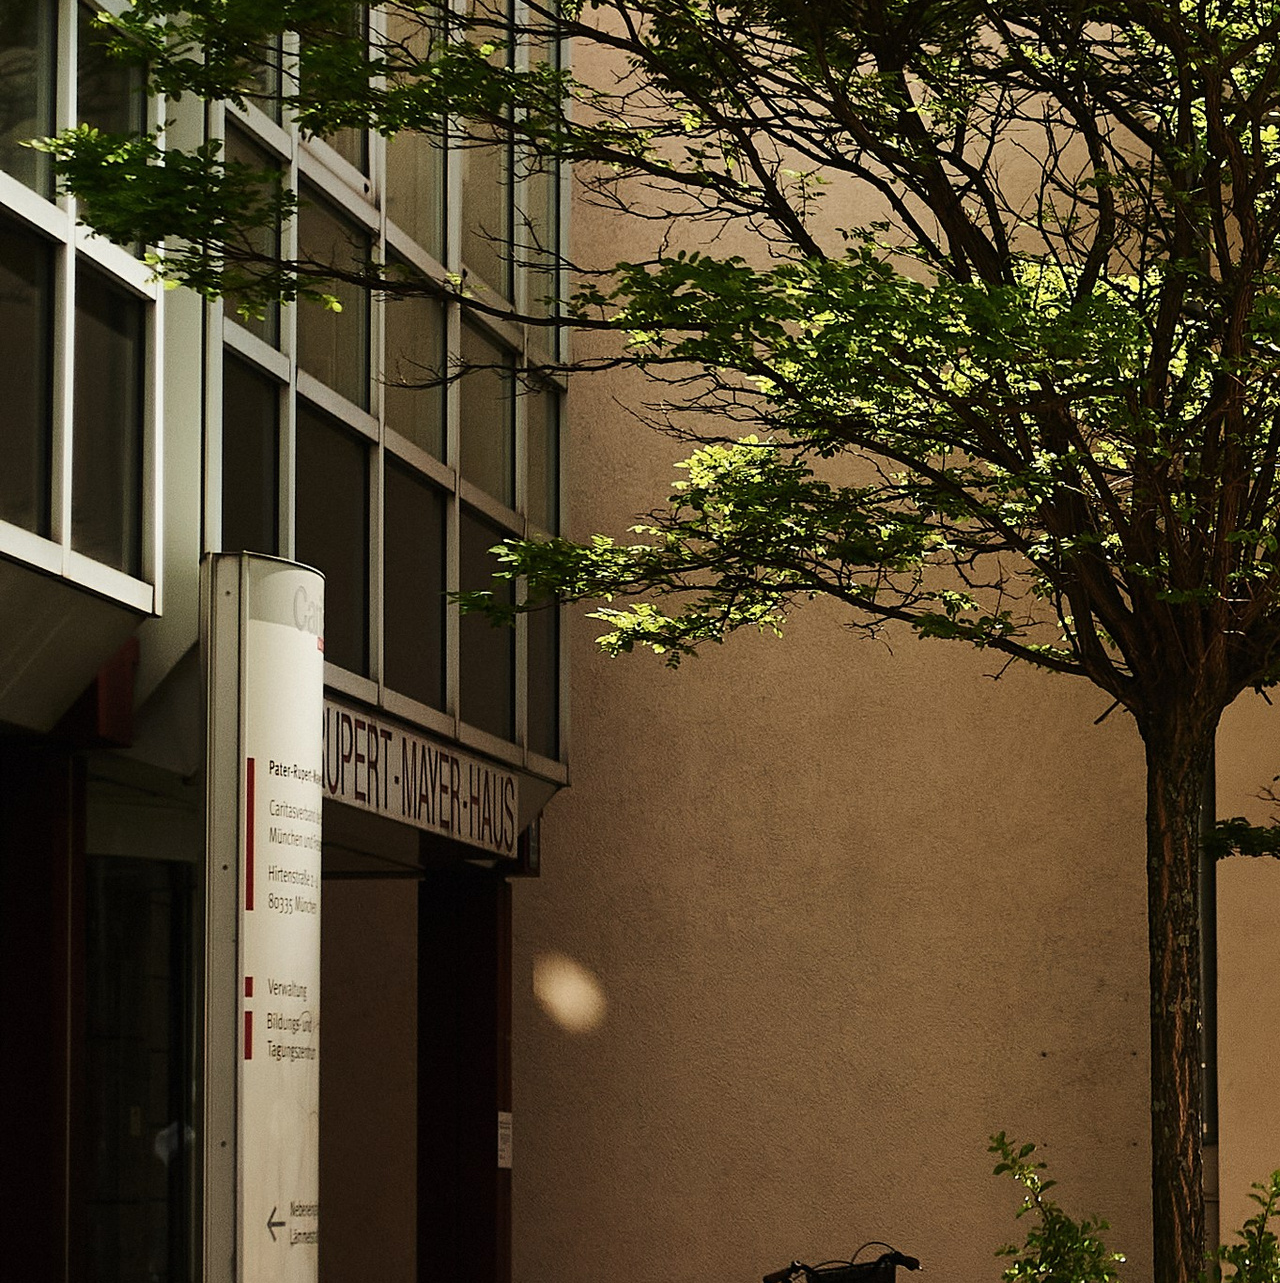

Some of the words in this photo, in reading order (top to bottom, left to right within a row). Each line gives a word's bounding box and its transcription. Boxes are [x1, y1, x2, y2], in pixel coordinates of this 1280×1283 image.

[323, 706, 515, 853] UPERT-MAYER-HAUS
[269, 826, 302, 846] München
[268, 892, 293, 915] 80335
[268, 978, 307, 1002] Verwaltung
